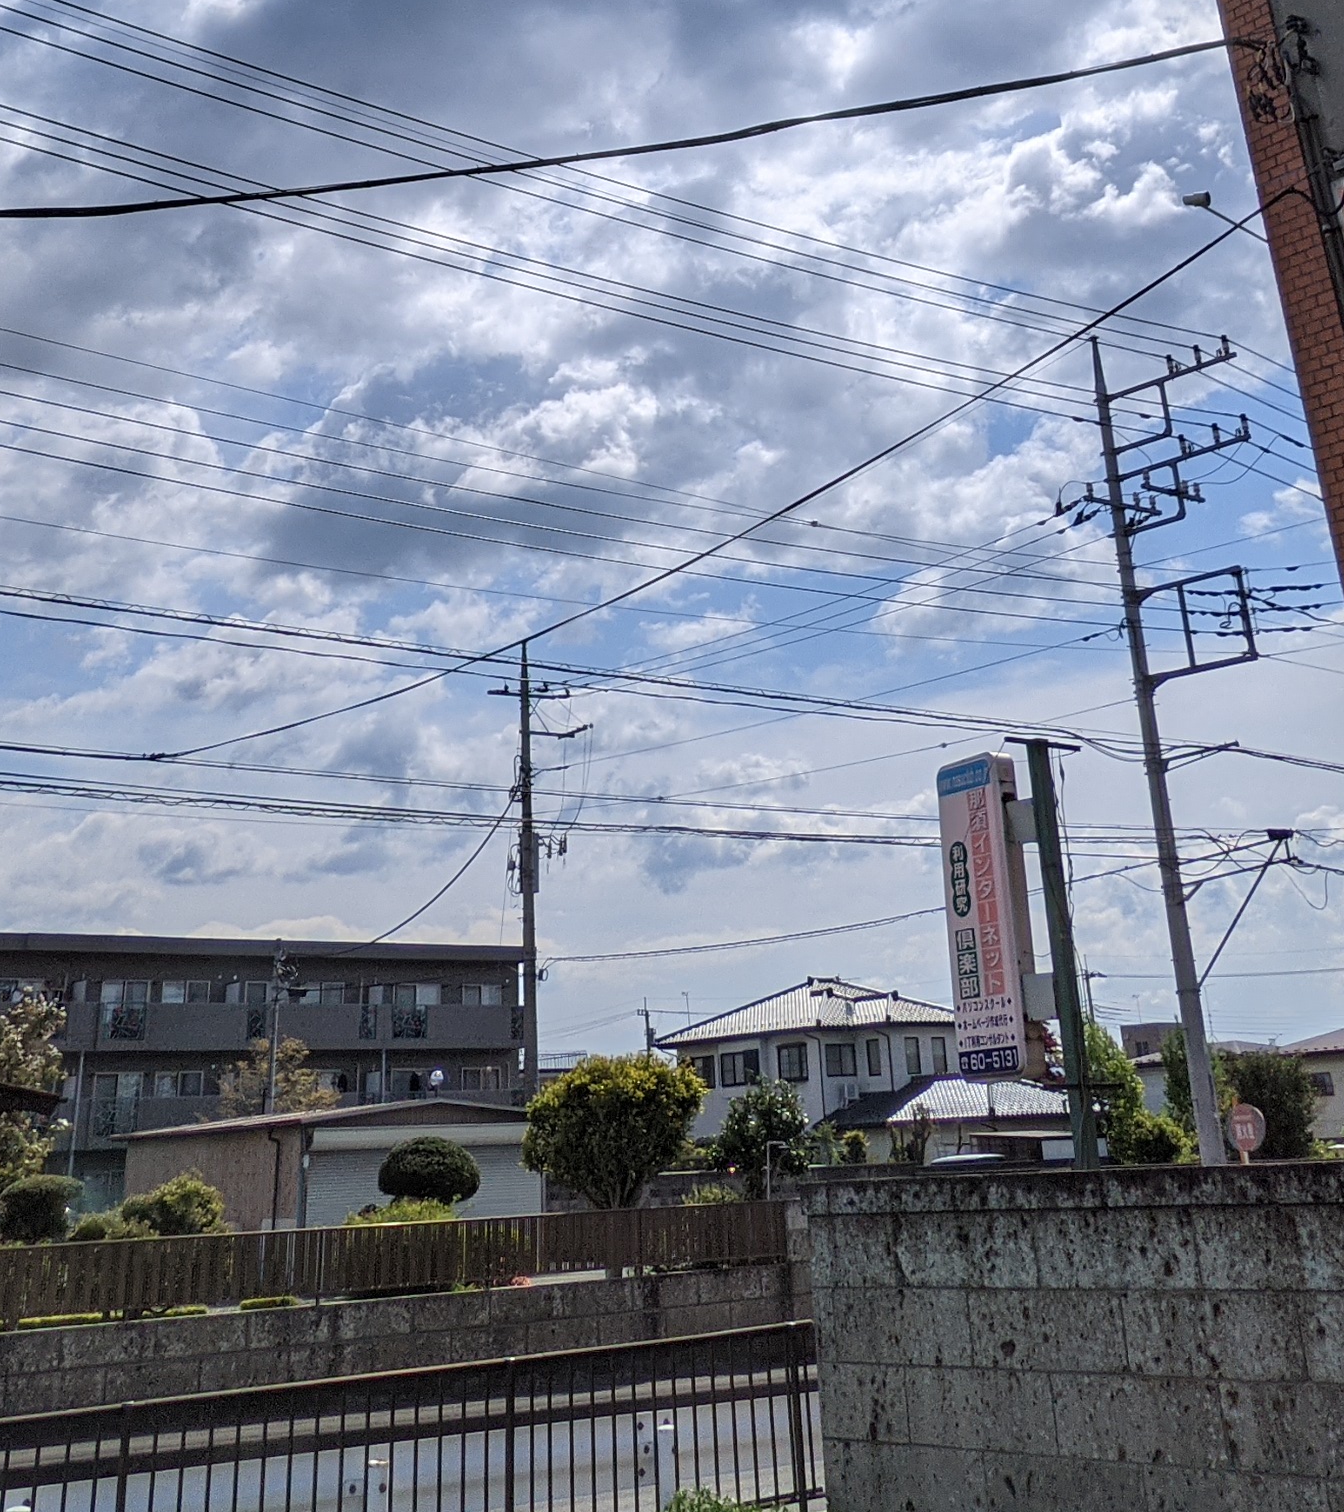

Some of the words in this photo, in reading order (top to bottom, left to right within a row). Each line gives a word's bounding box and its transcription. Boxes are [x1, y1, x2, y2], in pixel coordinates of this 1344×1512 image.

[952, 845, 968, 914] 利用研究
[967, 789, 1001, 994] 那須インターネット
[957, 929, 979, 998] 倶楽部
[970, 1049, 1018, 1071] 60-5131
